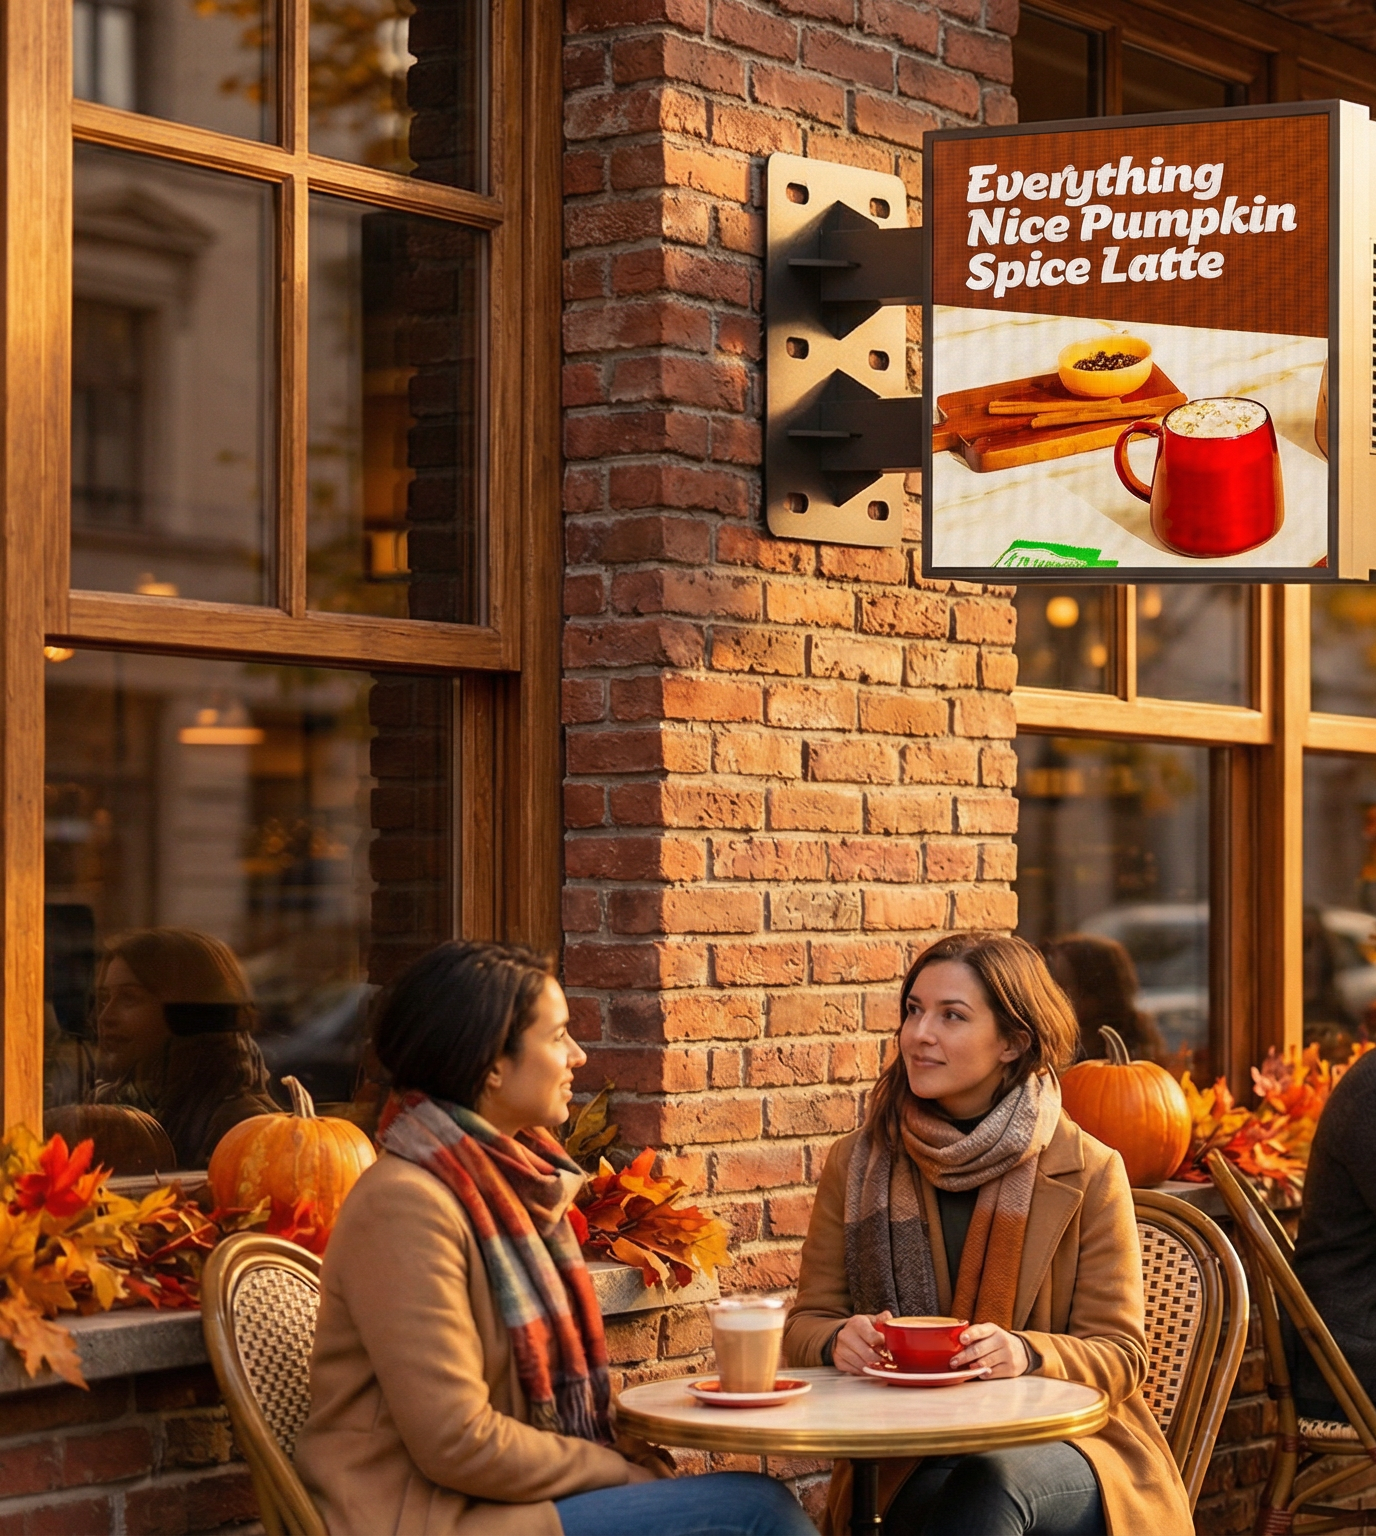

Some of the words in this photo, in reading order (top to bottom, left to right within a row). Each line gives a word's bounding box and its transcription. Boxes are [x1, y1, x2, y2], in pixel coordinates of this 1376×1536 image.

[966, 155, 1225, 207] Everything
[966, 207, 1071, 247] Nice
[1080, 194, 1298, 246] Pumpkin
[965, 249, 1091, 299] Spice
[1100, 245, 1225, 284] Latte
